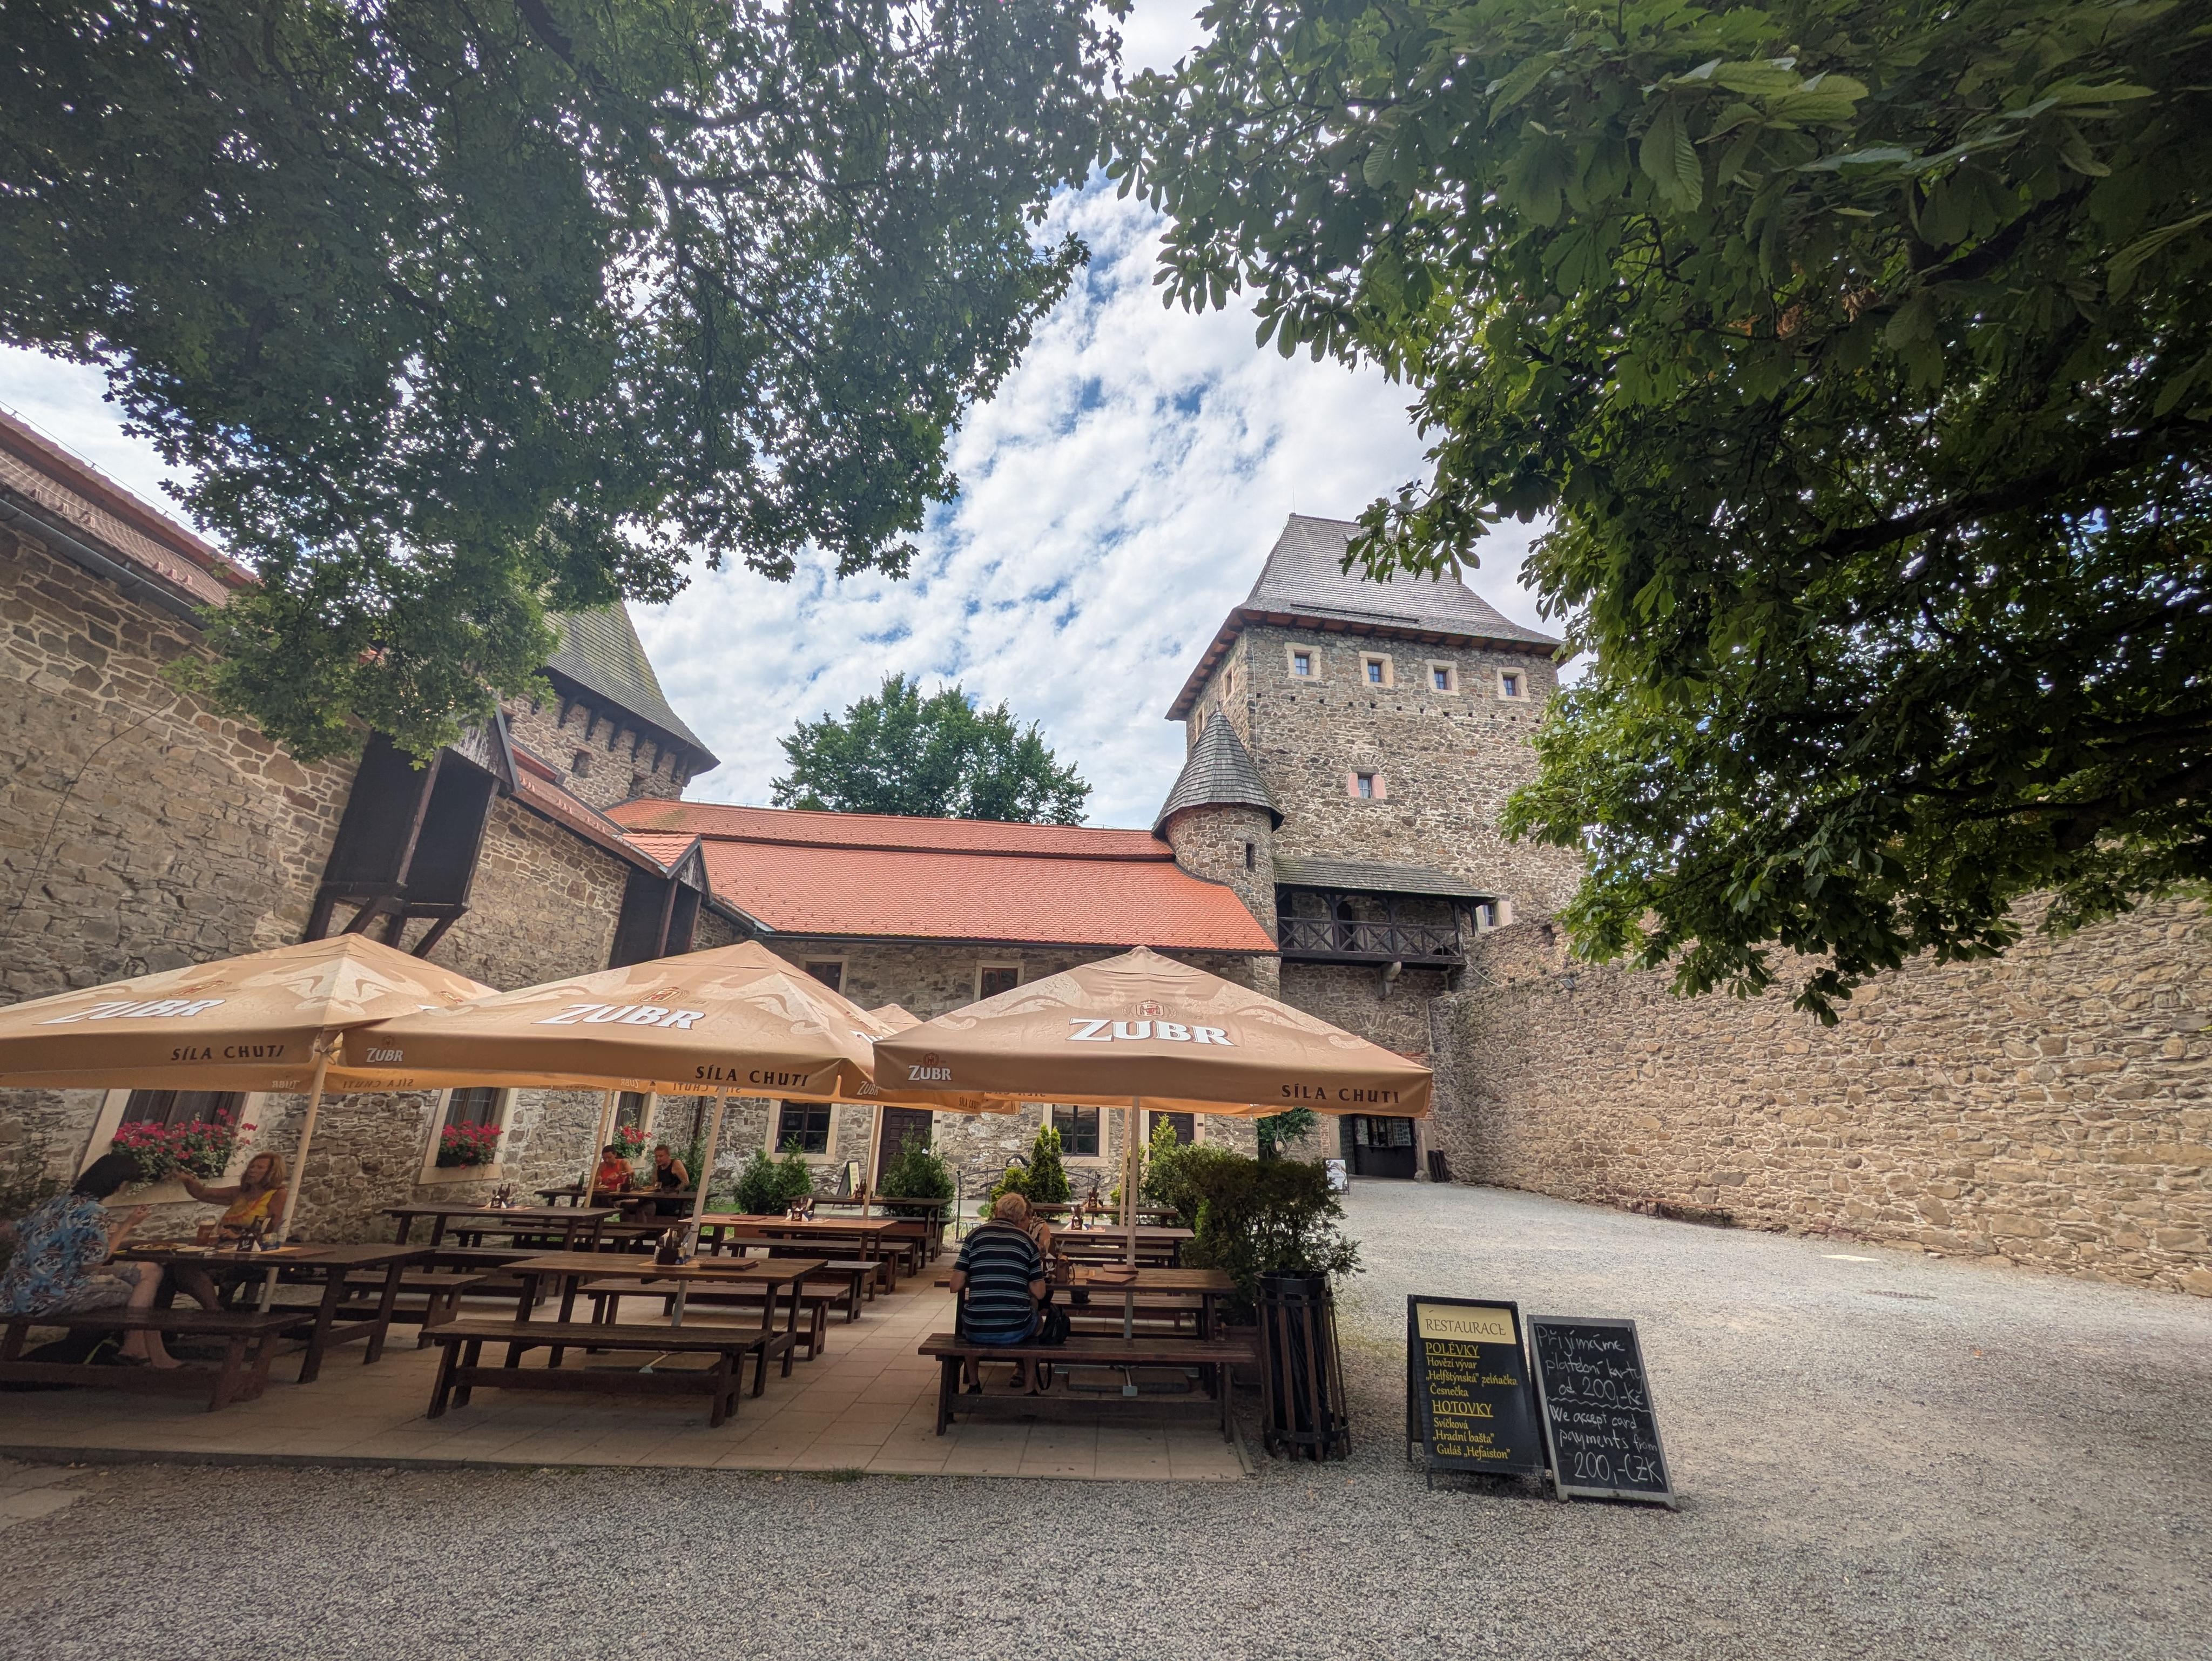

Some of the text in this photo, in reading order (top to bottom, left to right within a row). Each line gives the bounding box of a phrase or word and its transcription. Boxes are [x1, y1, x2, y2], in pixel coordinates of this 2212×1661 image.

[31, 999, 226, 1025] ZUBR
[530, 1004, 706, 1030] ZUBR
[1065, 1017, 1240, 1047] ZUBR
[171, 1045, 285, 1061] SÍLA CHUTI
[366, 1048, 403, 1063] ZUBR
[695, 1064, 809, 1087] SÍLA CHUTI
[907, 1065, 953, 1081] ZUBR
[857, 1081, 880, 1096] ZUBR
[1282, 1083, 1400, 1104] SÍLA CHUTI
[1425, 1319, 1507, 1335] RESTAURACE
[1426, 1342, 1479, 1357] POLÉVKY
[1427, 1356, 1477, 1371] Hovězí vývar
[1545, 1352, 1603, 1375] platební
[1430, 1382, 1469, 1397] Česnečka
[1559, 1376, 1576, 1395] od
[1432, 1400, 1492, 1416] HOTOVKY
[1434, 1417, 1468, 1429] Svíčková
[1550, 1405, 1637, 1430] We accept card
[1560, 1429, 1657, 1453] payments from
[1437, 1443, 1461, 1456] Guláš
